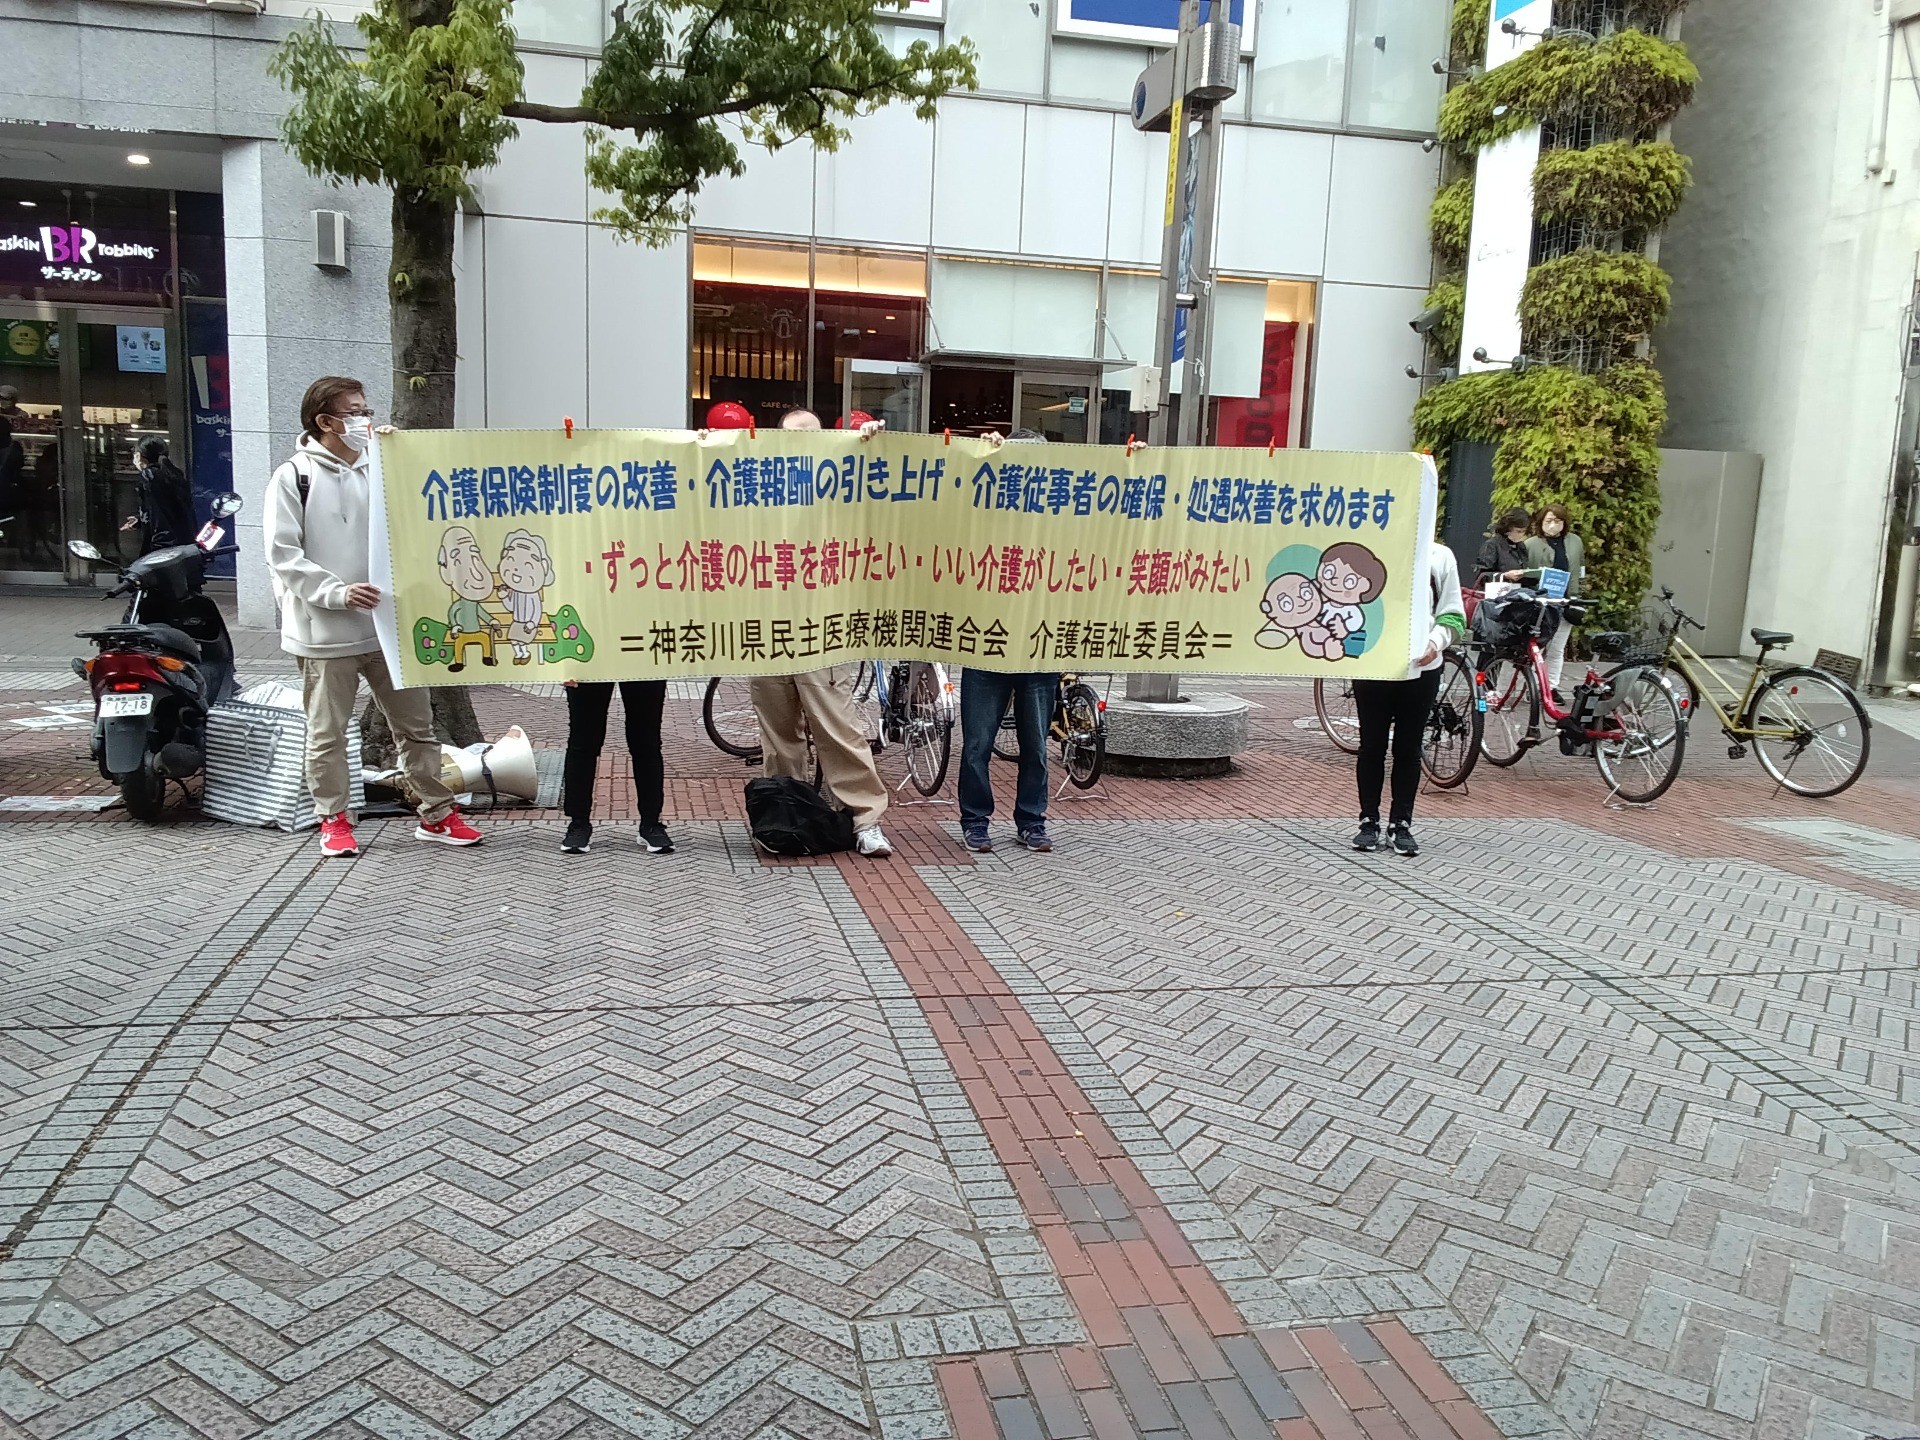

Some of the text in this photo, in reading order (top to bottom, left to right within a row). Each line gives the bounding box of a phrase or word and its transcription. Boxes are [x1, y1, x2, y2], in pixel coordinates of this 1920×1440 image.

[0, 234, 40, 252] askin
[40, 265, 103, 282] サーティワン
